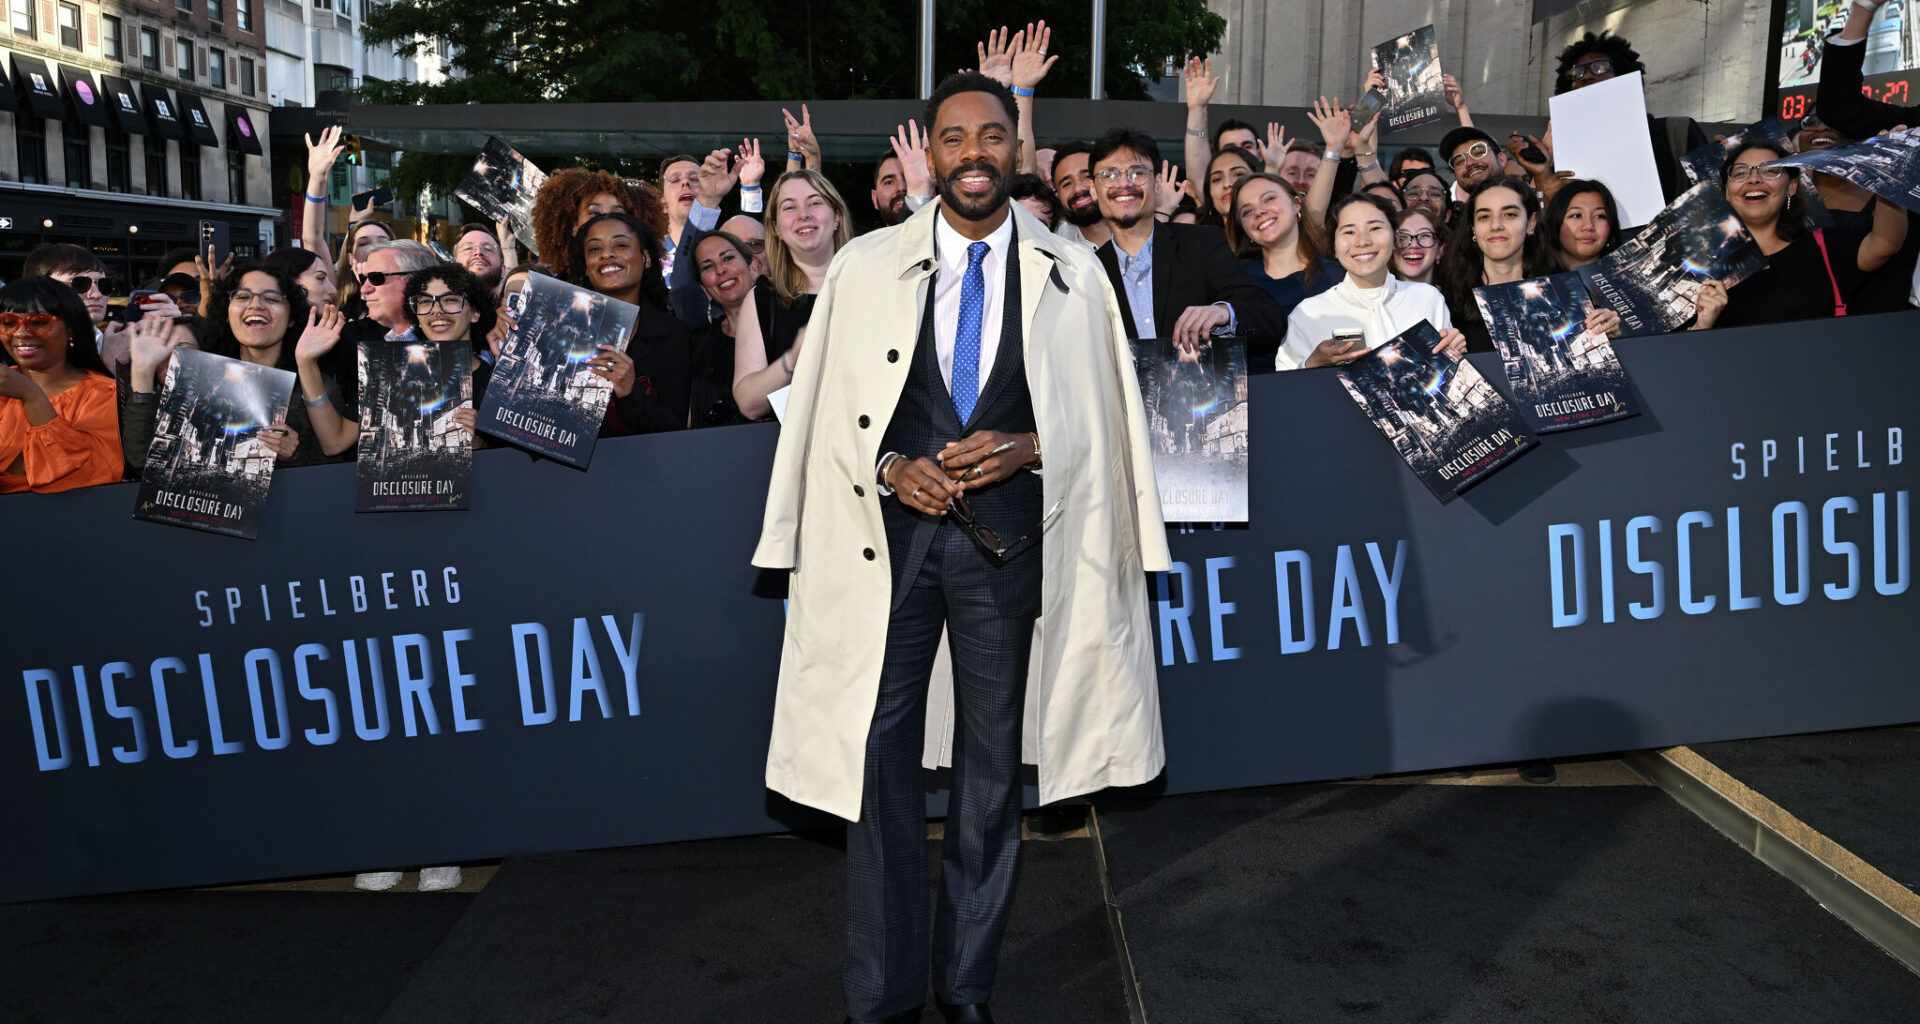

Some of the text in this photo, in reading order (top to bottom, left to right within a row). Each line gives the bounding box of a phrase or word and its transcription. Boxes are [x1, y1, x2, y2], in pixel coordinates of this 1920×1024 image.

[1389, 109, 1425, 127] DISCLOSURE
[1425, 106, 1437, 117] DAY
[1591, 272, 1632, 316] DISCLOSURE
[1624, 314, 1643, 331] DAY
[495, 406, 557, 440] DISCLOSURE
[558, 429, 579, 448] DAY
[1534, 391, 1616, 418] DISCLOSURE DAY
[1438, 438, 1496, 480] DISCLOSURE
[1491, 426, 1514, 446] DAY
[1731, 427, 1903, 481] SPIELB
[155, 490, 244, 520] DISCLOSURE DAY
[373, 480, 455, 496] DISCLOSURE DAY
[1162, 488, 1208, 505] CLOSURE
[1548, 490, 1910, 629] DISCLOSU
[195, 566, 461, 627] SPIELBERG
[1156, 539, 1409, 667] RE DAY
[22, 612, 645, 772] DISCLOSURE DAY
